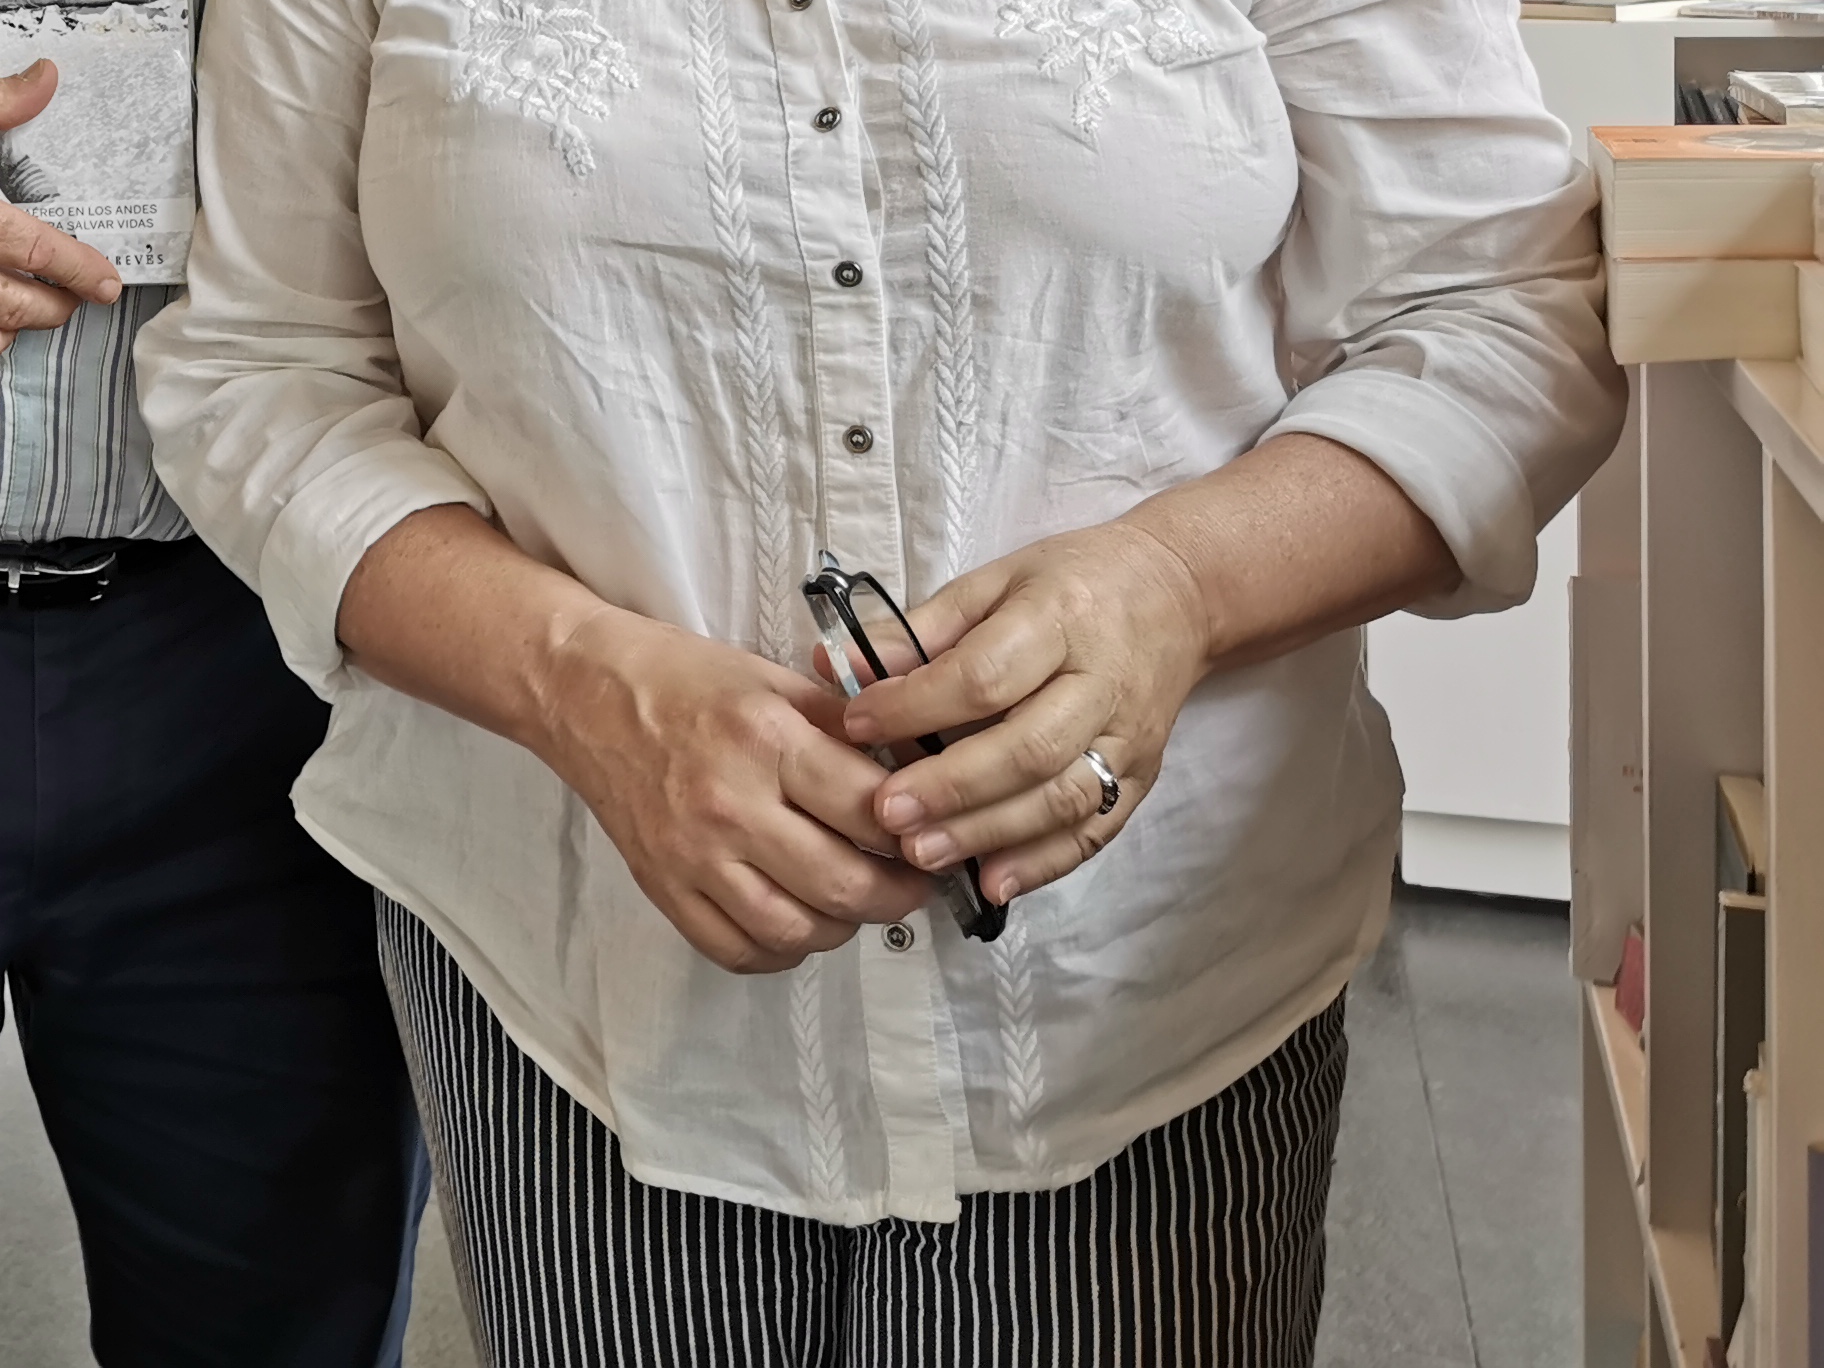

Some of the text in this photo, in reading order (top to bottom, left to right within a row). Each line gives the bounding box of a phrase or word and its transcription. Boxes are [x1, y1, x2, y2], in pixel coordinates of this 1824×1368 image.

[68, 206, 85, 217] EN
[88, 205, 113, 216] LOS
[115, 204, 158, 215] ANDES
[66, 220, 115, 231] SALVAR
[116, 218, 155, 229] VIDAS
